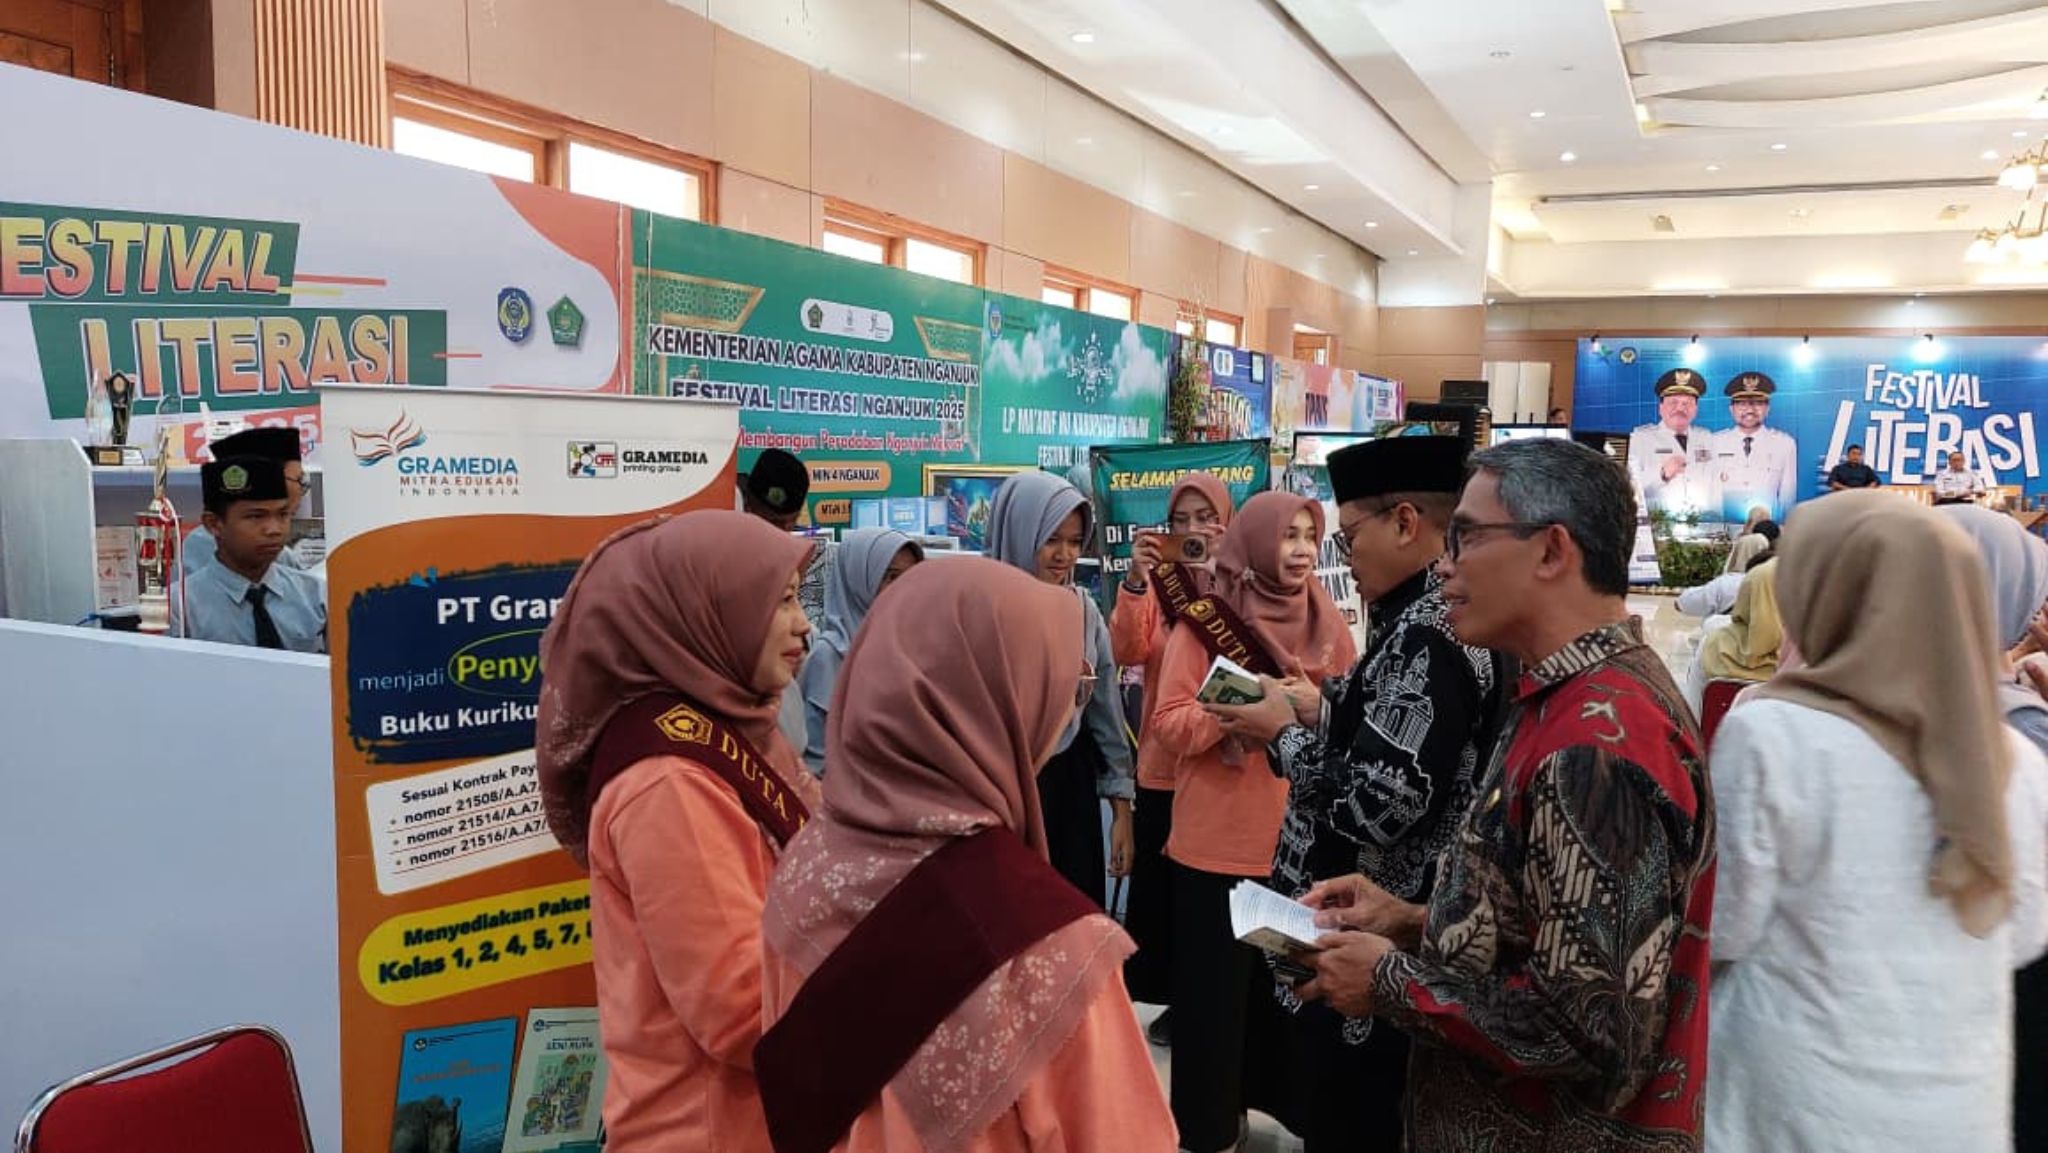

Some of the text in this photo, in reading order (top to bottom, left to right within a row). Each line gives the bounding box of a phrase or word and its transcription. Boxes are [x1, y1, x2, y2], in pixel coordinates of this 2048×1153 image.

[0, 217, 281, 298] ESTIVAL
[81, 315, 408, 398] LITERASI
[648, 323, 980, 387] KEMENTERIAN AGAMA KABUPATEN NGANJUK
[670, 378, 966, 421] FESTIVAL LITERASI NGANJUK 2025
[1865, 364, 1991, 415] FESTIVAL
[193, 413, 319, 462] 25
[622, 451, 708, 464] GRAMEDIA
[1823, 400, 2040, 487] LITERASI
[398, 457, 519, 475] GRAMEDIA
[400, 477, 519, 486] MITRA EDUKASI
[623, 464, 681, 473] printing group
[839, 468, 880, 482] NGANJUK
[1110, 469, 1186, 490] SELAMAT
[400, 488, 520, 496] INDONESIA
[1105, 525, 1122, 543] Di
[437, 597, 480, 624] PT
[1206, 617, 1252, 667] DUTA
[358, 655, 545, 692] menjadi Peny
[380, 702, 539, 736] Buku Kuriku
[401, 763, 537, 803] Sesuai Kontrak Pay
[721, 730, 789, 821] DUTA
[404, 804, 452, 824] nomor
[407, 801, 543, 845] nomor 21514/A.A7/
[410, 819, 547, 866] nomor 21516/A.A7/
[403, 902, 535, 948] Menyediakan
[378, 955, 445, 984] Kelas
[452, 948, 473, 969] 1,
[479, 941, 500, 962] 2,
[505, 935, 527, 956] 4,
[533, 929, 554, 949] 5,
[559, 923, 580, 944] 7,
